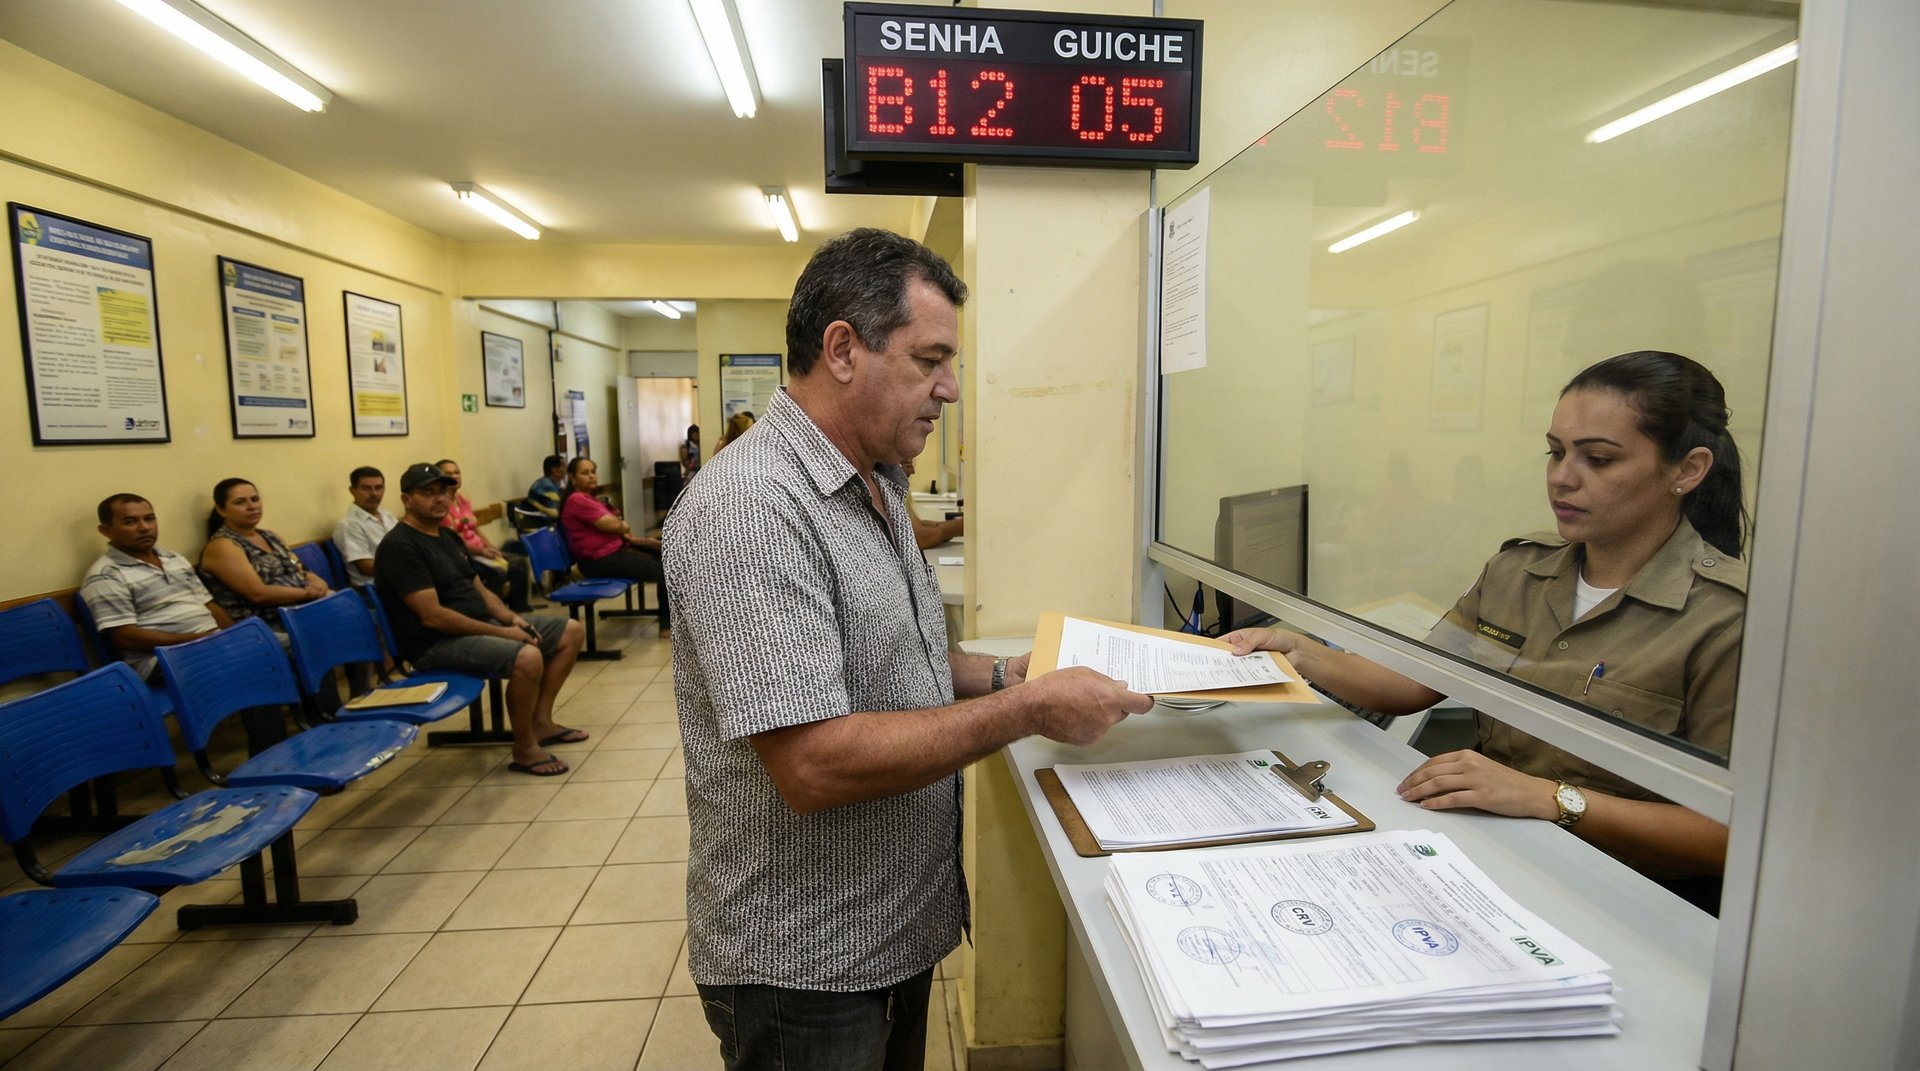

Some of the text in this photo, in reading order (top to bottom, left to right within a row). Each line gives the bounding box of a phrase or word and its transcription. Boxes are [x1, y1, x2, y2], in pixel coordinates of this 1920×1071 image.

[879, 20, 1184, 63] SENHA GUICHE
[868, 65, 1165, 142] B12 05
[1292, 907, 1316, 926] CRV
[1411, 927, 1439, 949] IPVA
[1514, 937, 1555, 966] IPVA
